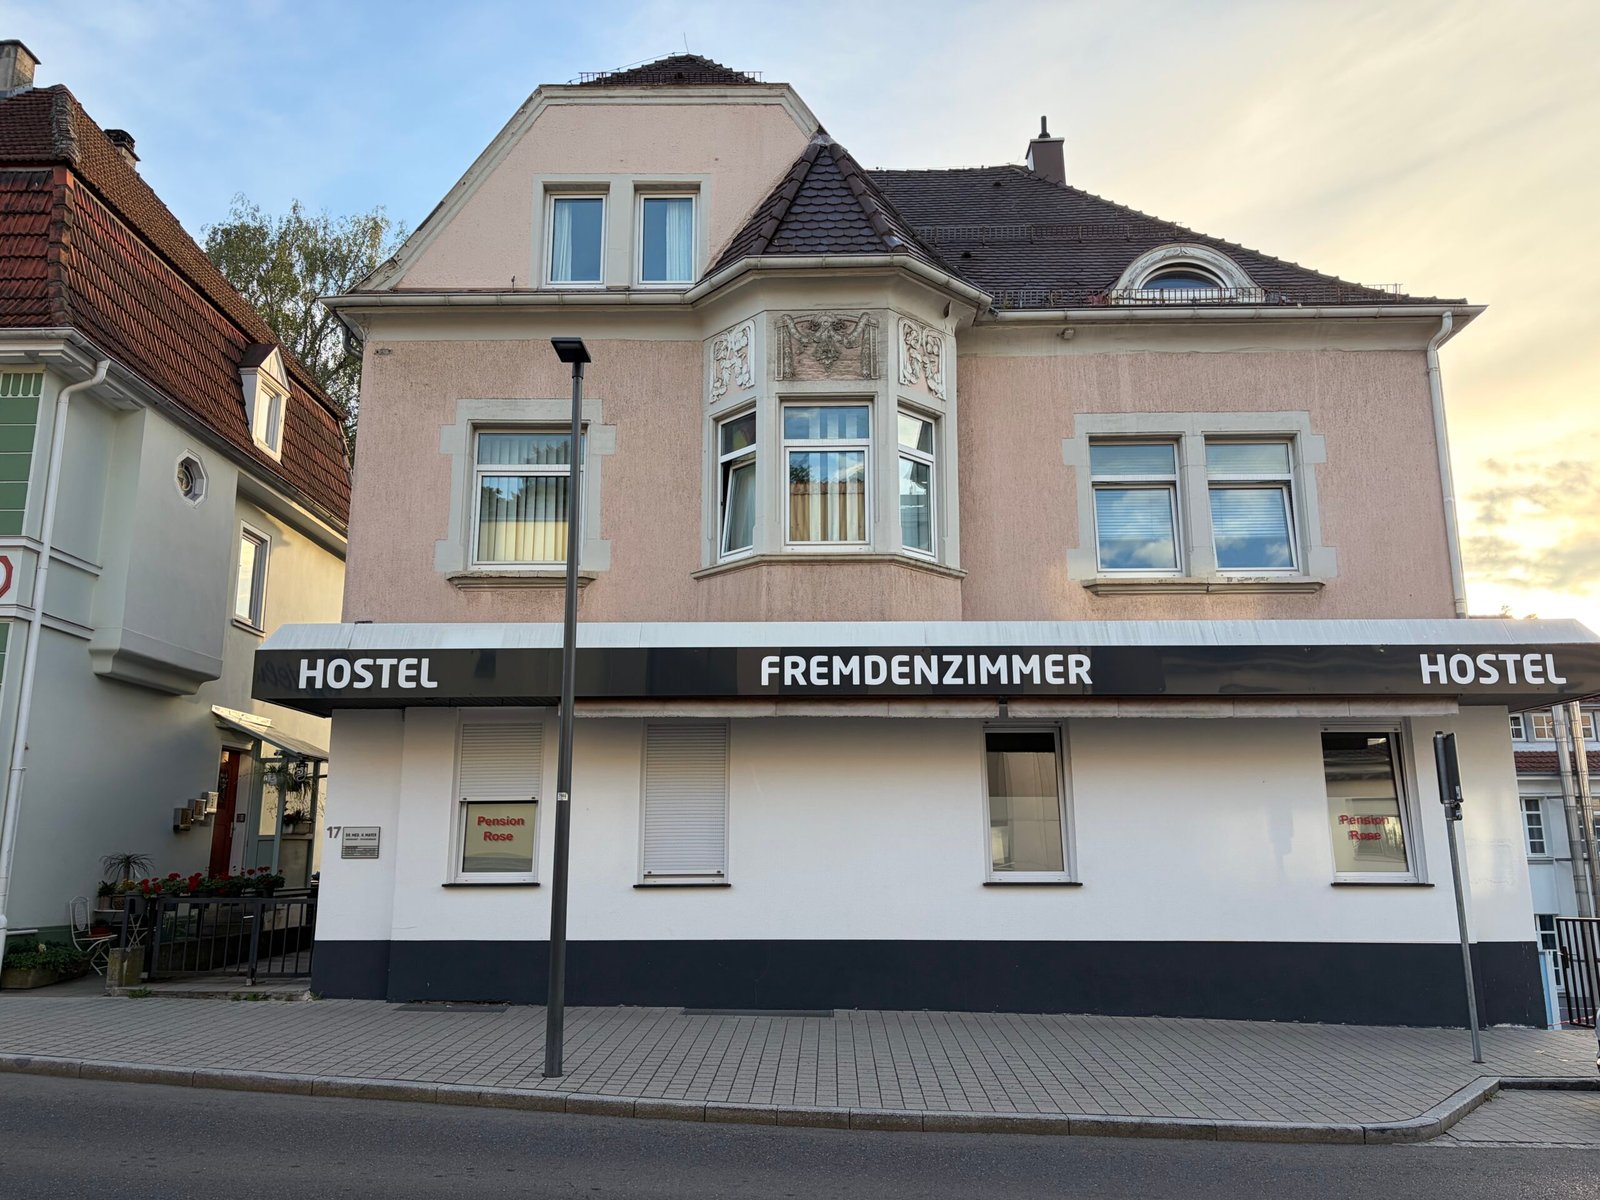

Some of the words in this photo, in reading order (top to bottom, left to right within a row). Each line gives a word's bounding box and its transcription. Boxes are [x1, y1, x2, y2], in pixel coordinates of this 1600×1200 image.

[298, 657, 438, 690] HOSTEL
[760, 654, 1093, 686] FREMDENZIMMER
[1419, 653, 1567, 685] HOSTEL
[477, 815, 525, 826] Pension
[1338, 814, 1390, 825] Pension
[326, 826, 342, 839] 17
[483, 831, 514, 841] Rose
[1348, 830, 1382, 840] Rose
